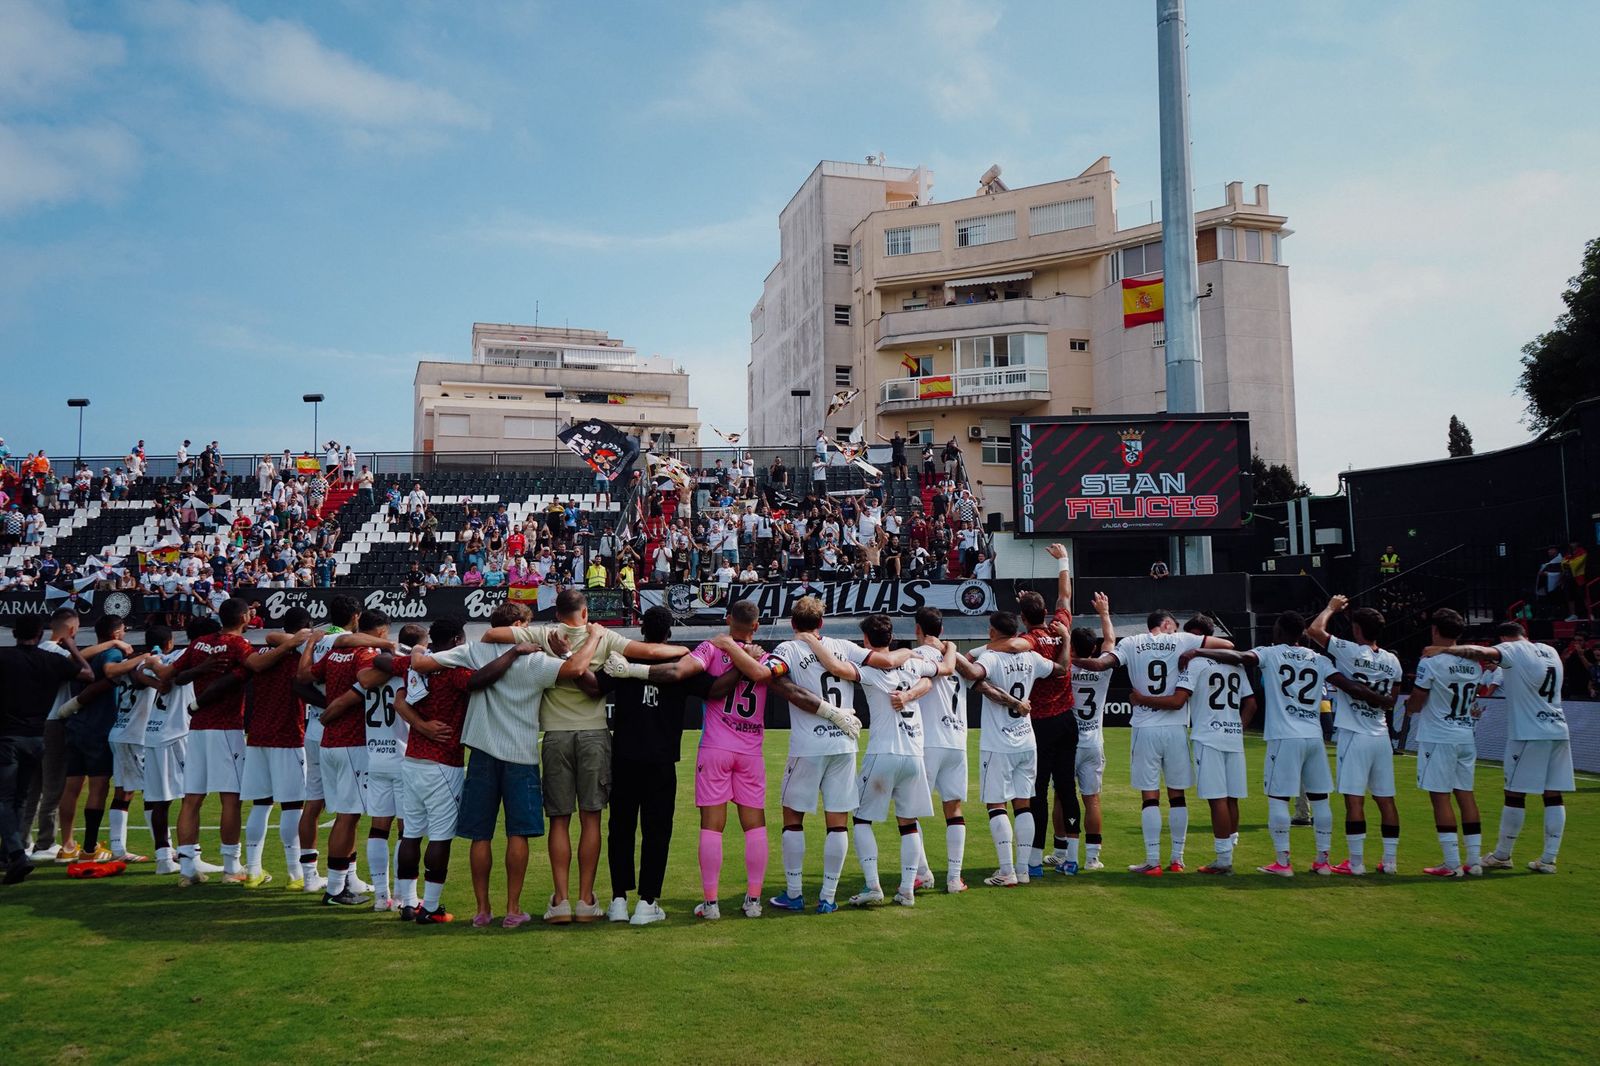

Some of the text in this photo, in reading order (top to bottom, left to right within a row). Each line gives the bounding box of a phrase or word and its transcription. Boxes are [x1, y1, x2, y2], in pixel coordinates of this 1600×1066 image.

[1021, 437, 1034, 514] ADC 2026
[1081, 473, 1186, 496] SEAN
[1065, 495, 1219, 520] FELICES
[287, 591, 308, 601] Café
[386, 591, 407, 600] Café
[486, 590, 507, 600] Café
[820, 670, 842, 708] 6
[1072, 673, 1100, 682] MATOS
[1148, 660, 1168, 695] 9
[1208, 672, 1241, 710] 28
[1279, 664, 1318, 705] 22
[1538, 667, 1557, 704] 4
[366, 684, 396, 728] 26
[1077, 687, 1097, 720] 3
